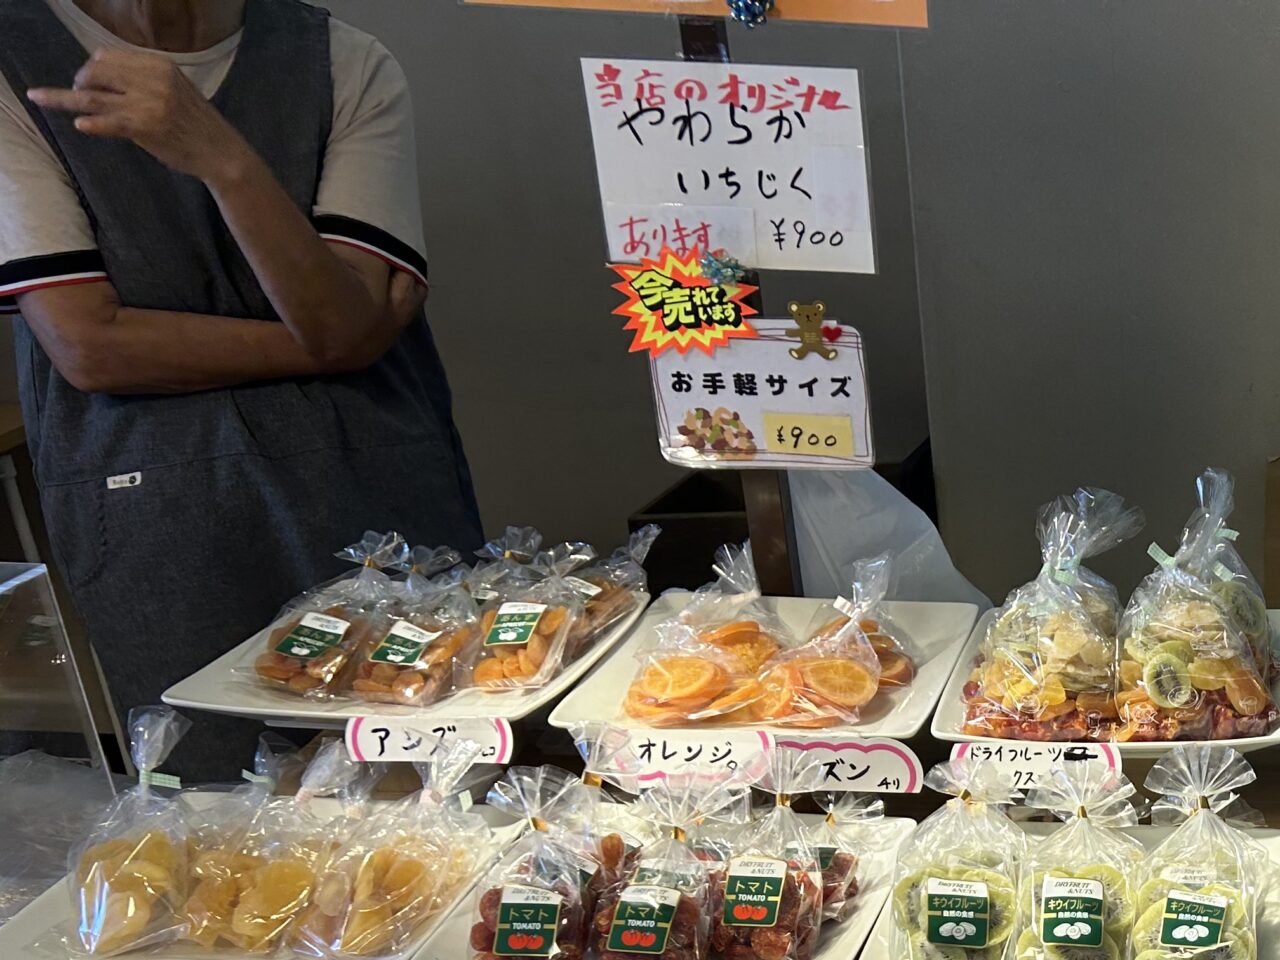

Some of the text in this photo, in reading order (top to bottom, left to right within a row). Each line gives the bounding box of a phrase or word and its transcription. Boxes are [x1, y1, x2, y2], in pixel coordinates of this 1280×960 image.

[594, 63, 853, 113] 当店のオリジナル
[618, 98, 806, 146] やわらか
[677, 167, 811, 200] いちじく
[770, 219, 844, 250] ¥900
[671, 371, 852, 398] お手軽サイズ
[777, 427, 837, 448] ¥900
[735, 880, 773, 893] トマト
[738, 894, 765, 902] TOMATO
[932, 897, 984, 909] キウイフルーツ
[1048, 898, 1098, 911] キウイフルーツ
[509, 908, 549, 920] トマト
[626, 906, 663, 918] トマト
[1170, 901, 1221, 916] キウイフルーツ
[512, 922, 541, 930] TOMATO
